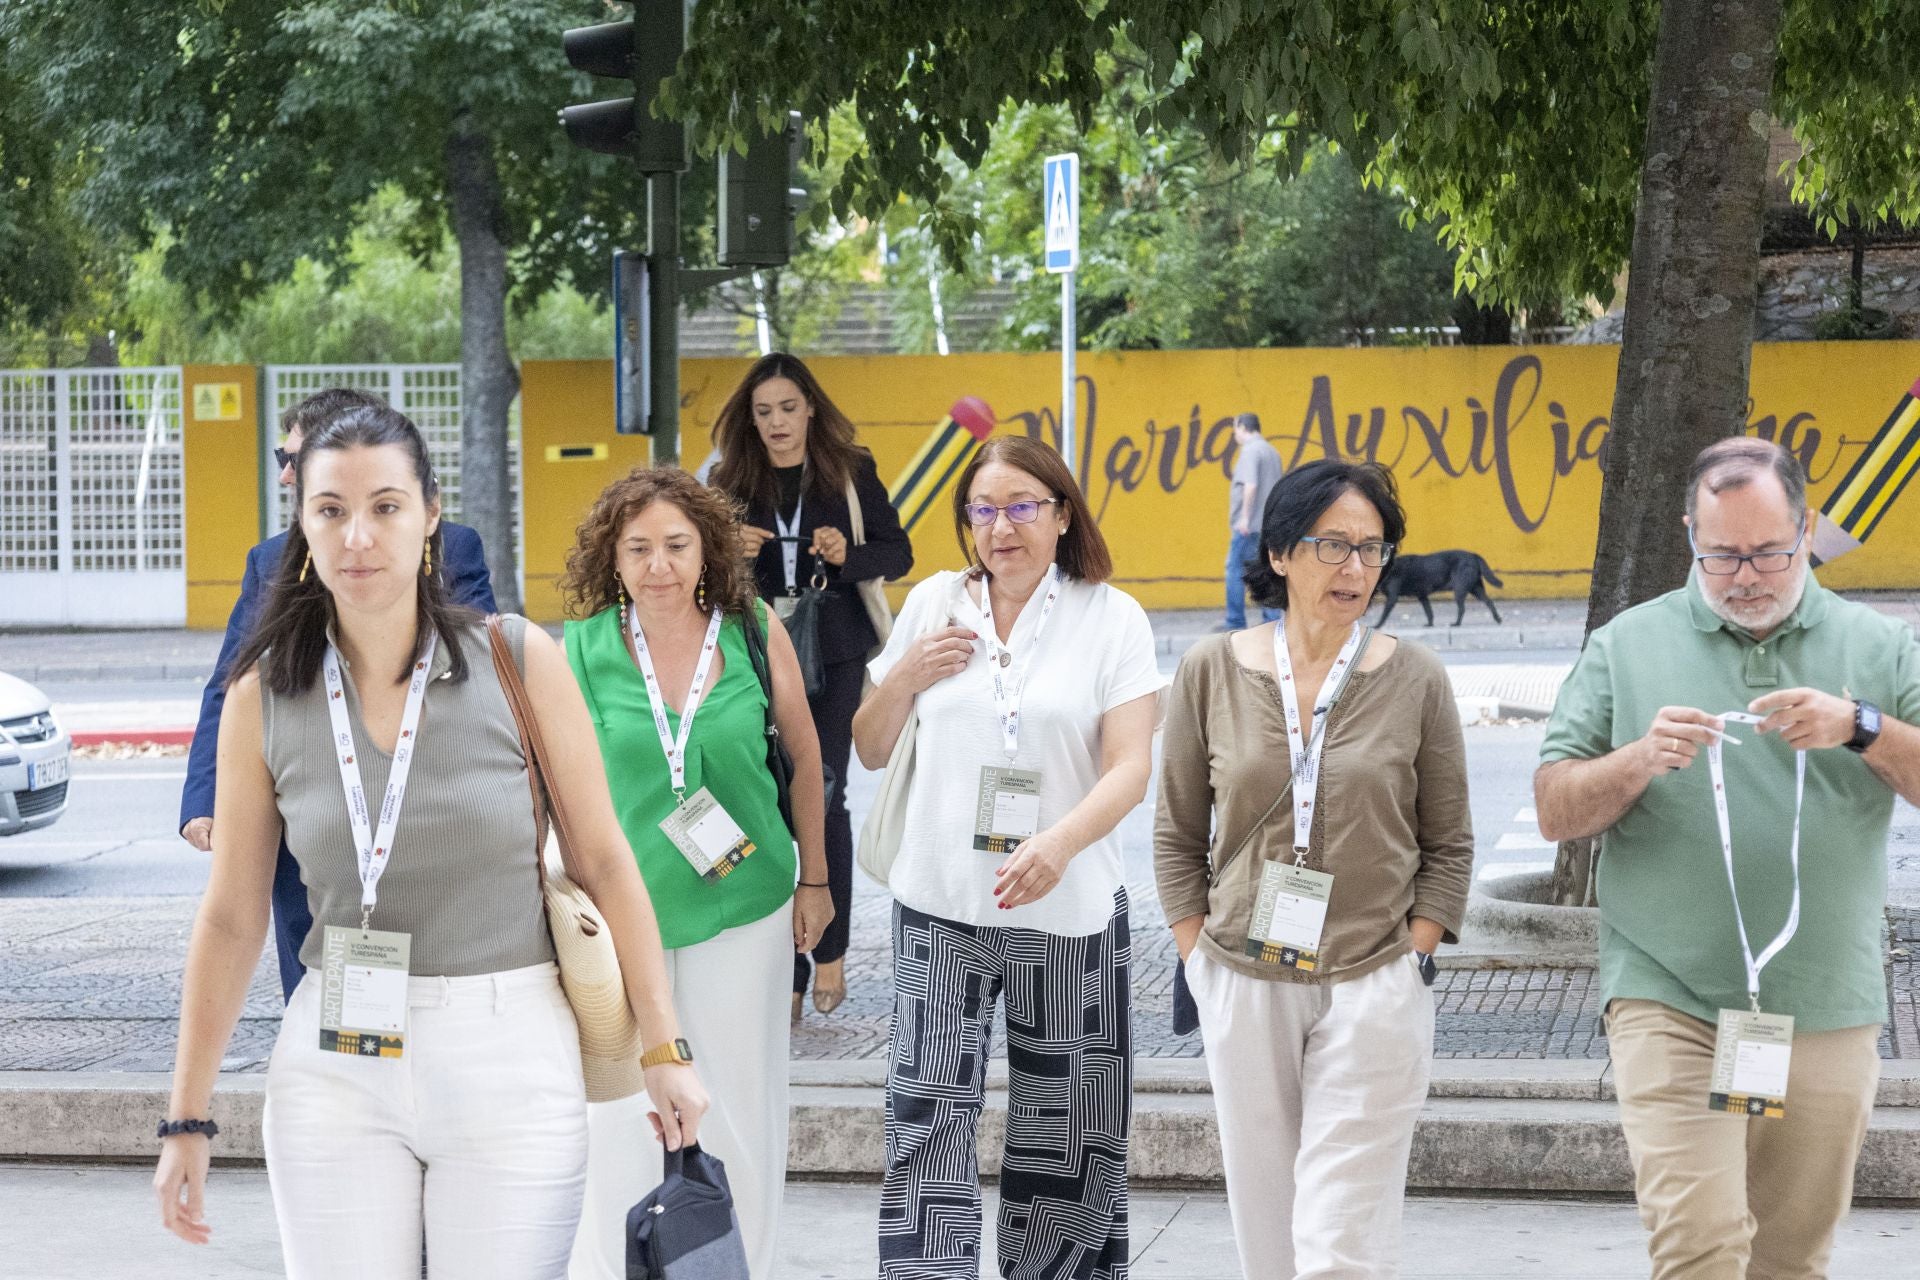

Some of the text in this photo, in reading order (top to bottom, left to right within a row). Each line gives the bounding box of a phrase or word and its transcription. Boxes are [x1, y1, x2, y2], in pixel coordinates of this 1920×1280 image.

[978, 768, 997, 834] PARTICIPANTE
[1252, 864, 1282, 939] PARTICIPANTE
[323, 932, 346, 1028] PARTICIPANTE
[1716, 1012, 1740, 1092] PARTICIPANTE
